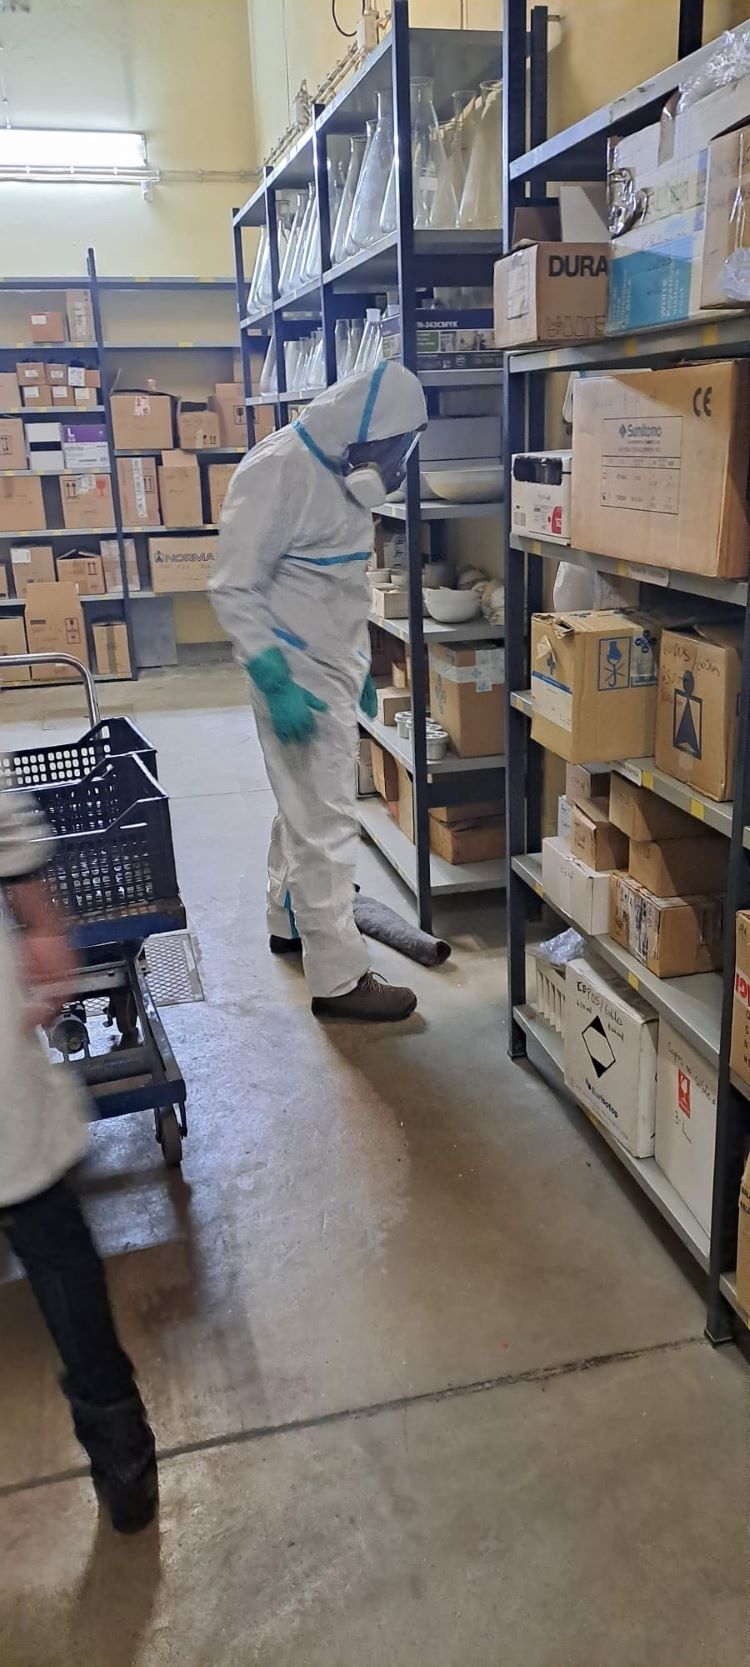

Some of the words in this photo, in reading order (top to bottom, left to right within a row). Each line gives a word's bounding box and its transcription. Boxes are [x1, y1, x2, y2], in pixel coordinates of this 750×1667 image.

[692, 386, 712, 417] CE
[67, 427, 75, 437] L
[627, 424, 662, 438] Sumitomo
